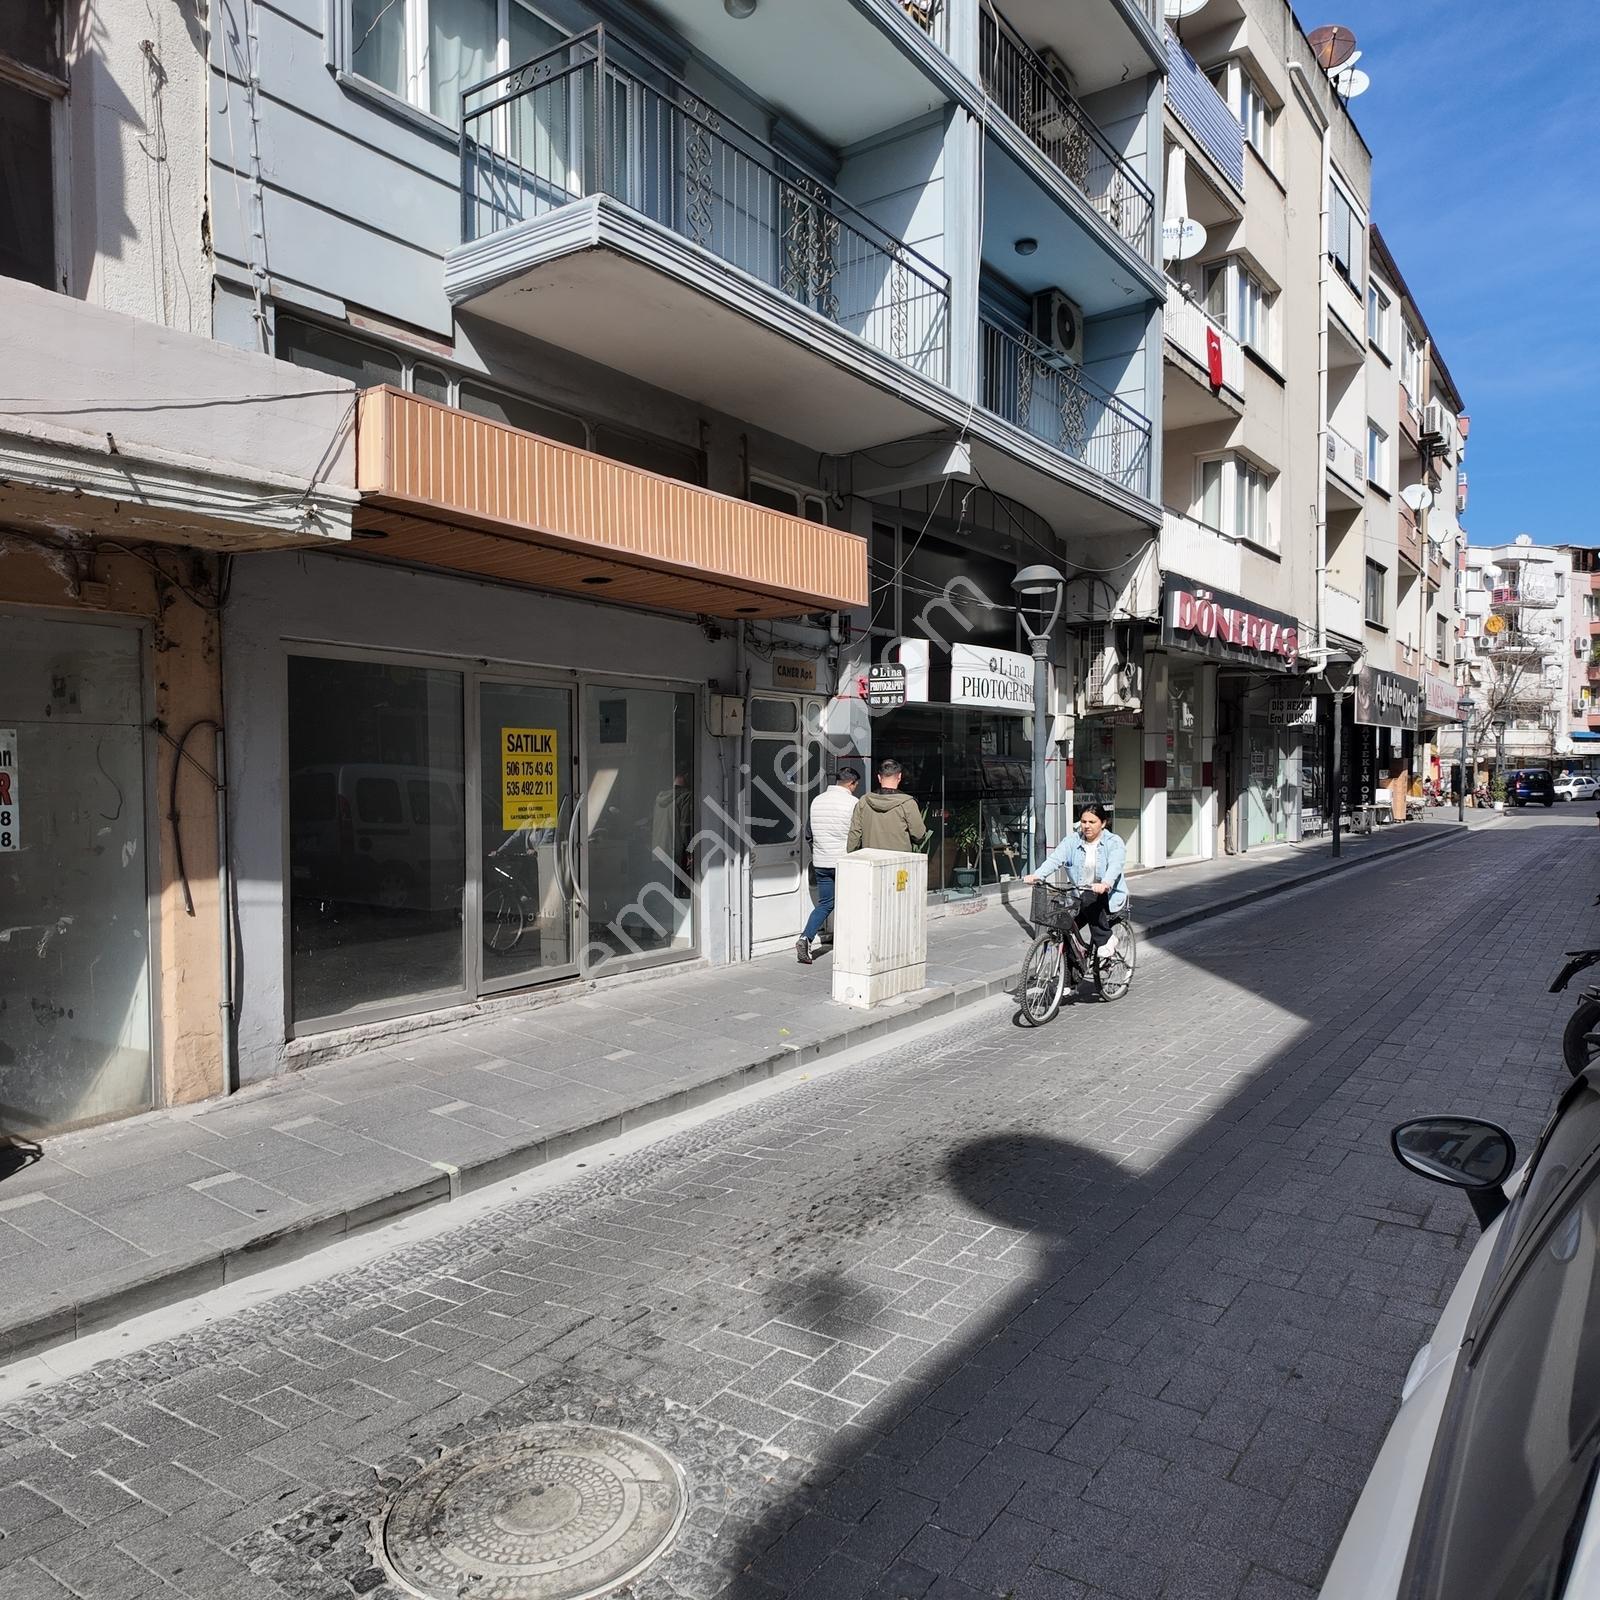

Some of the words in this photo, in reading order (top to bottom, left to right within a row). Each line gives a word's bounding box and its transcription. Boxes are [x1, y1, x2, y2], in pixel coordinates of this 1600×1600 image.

[1173, 589, 1298, 667] DÖNERTAŞ
[777, 665, 800, 678] CANER
[880, 667, 903, 677] Lina
[1000, 657, 1026, 679] Lina
[1375, 674, 1402, 712] Aytekin
[1271, 713, 1284, 724] Erol
[1286, 713, 1313, 724] ULUSOY
[507, 734, 552, 753] SATILIK
[507, 762, 520, 776] 506
[522, 762, 534, 776] 175
[535, 762, 544, 776] 43
[545, 762, 553, 776] 43
[507, 781, 520, 796] 535
[521, 781, 534, 796] 492
[535, 781, 544, 796] 22
[545, 781, 553, 795] 11
